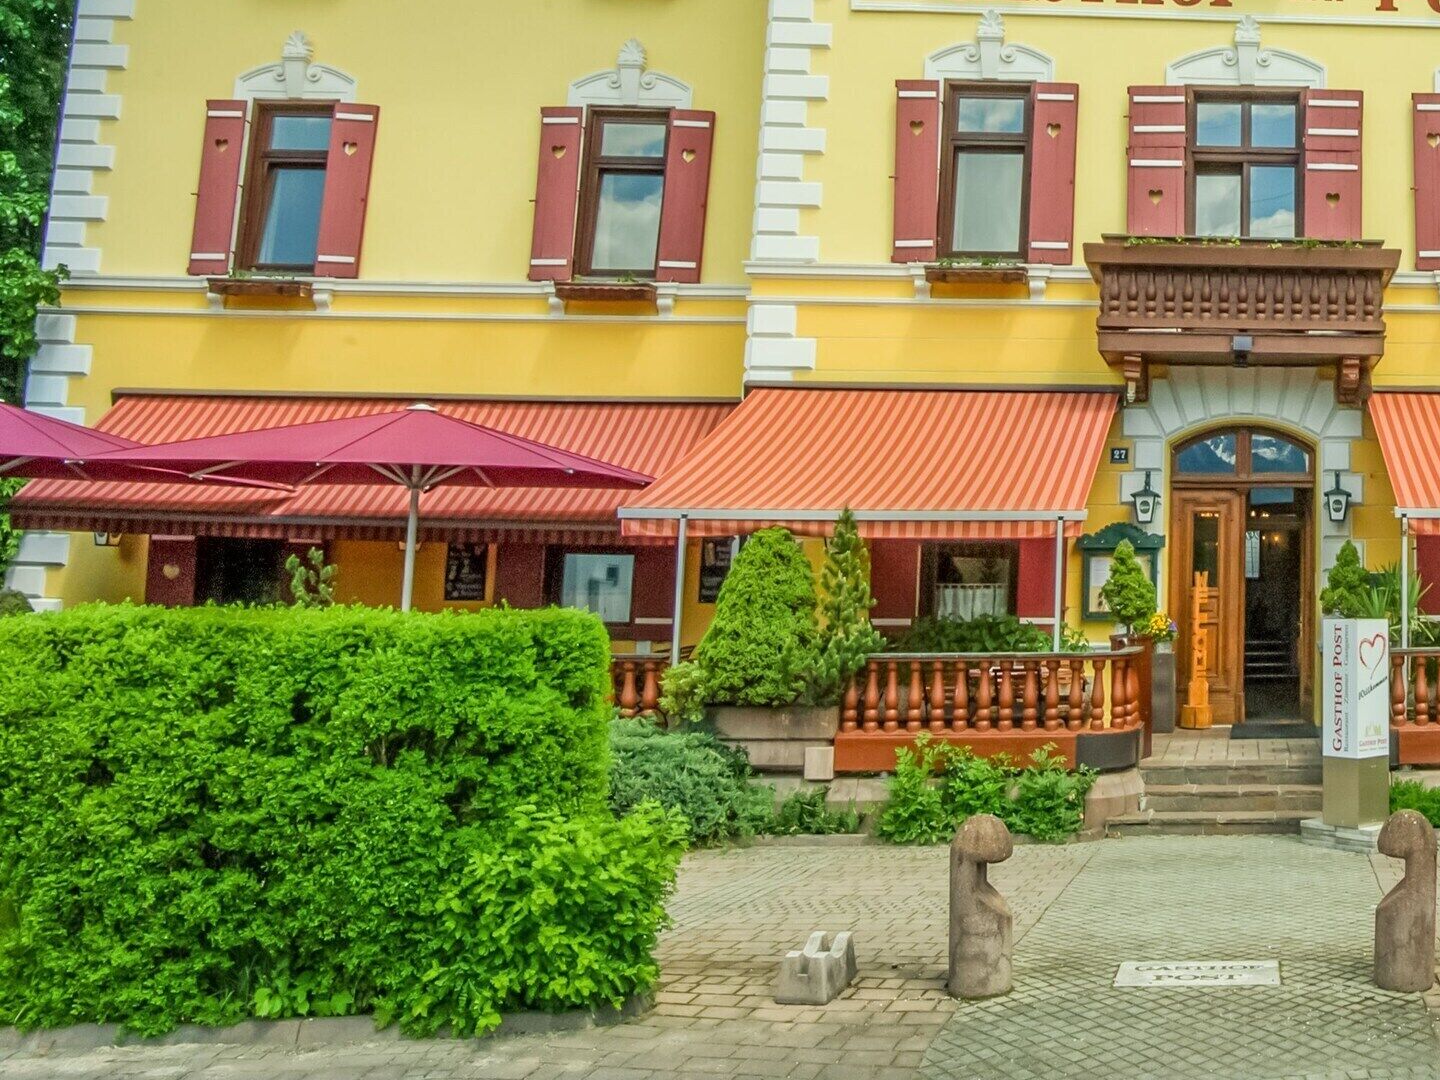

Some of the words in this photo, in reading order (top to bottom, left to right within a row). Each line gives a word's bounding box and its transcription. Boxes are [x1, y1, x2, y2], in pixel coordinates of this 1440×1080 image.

[1113, 449, 1127, 459] 27
[1332, 624, 1343, 667] POST
[1332, 672, 1343, 752] GASTHOF
